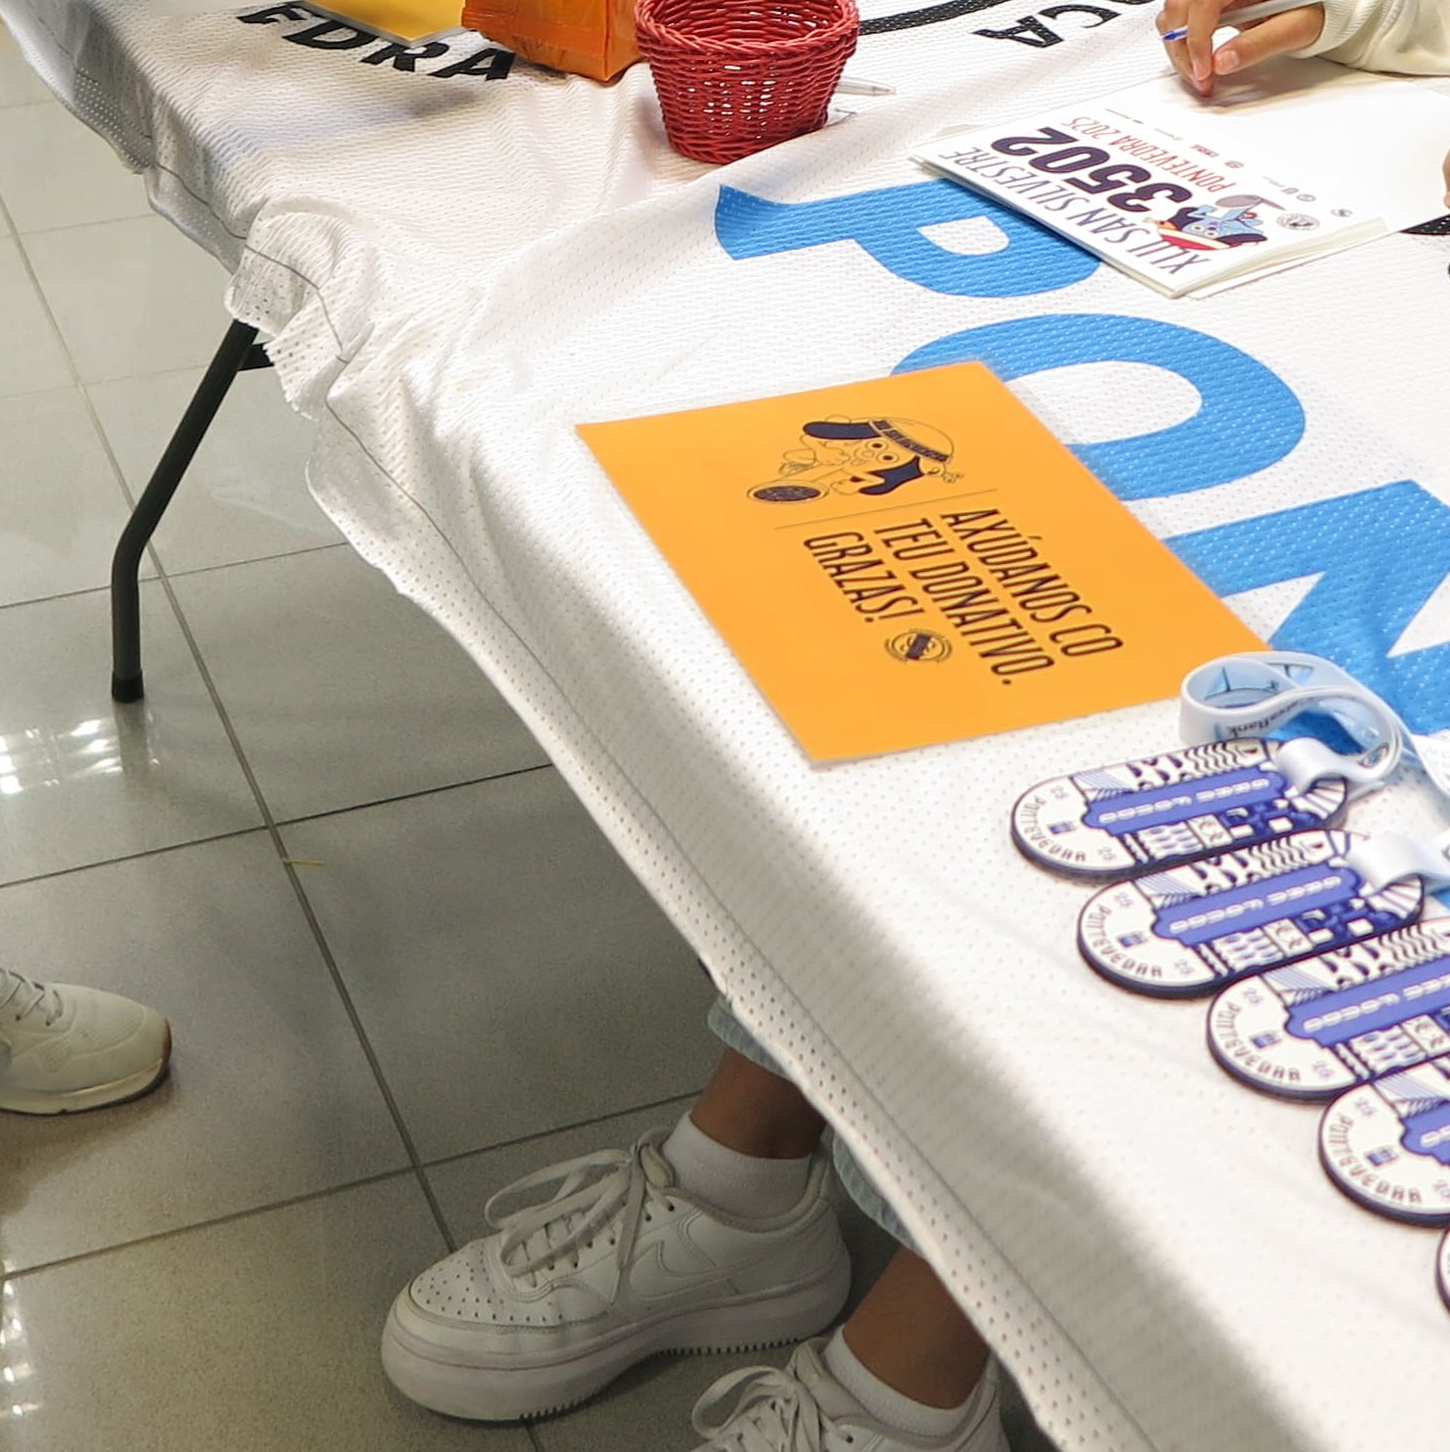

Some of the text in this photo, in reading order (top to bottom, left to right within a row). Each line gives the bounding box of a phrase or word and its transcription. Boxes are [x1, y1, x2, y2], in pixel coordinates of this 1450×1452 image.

[937, 147, 1090, 212] SILVESTRE
[990, 127, 1193, 213] 3502
[1108, 133, 1236, 193] PONTEVEDRA
[1075, 207, 1150, 244] SAN
[803, 531, 924, 623] GRAZAS!
[874, 518, 954, 561] TEU
[940, 509, 1123, 657] AXÚDANOS CO
[910, 561, 1055, 685] DONATIVO.
